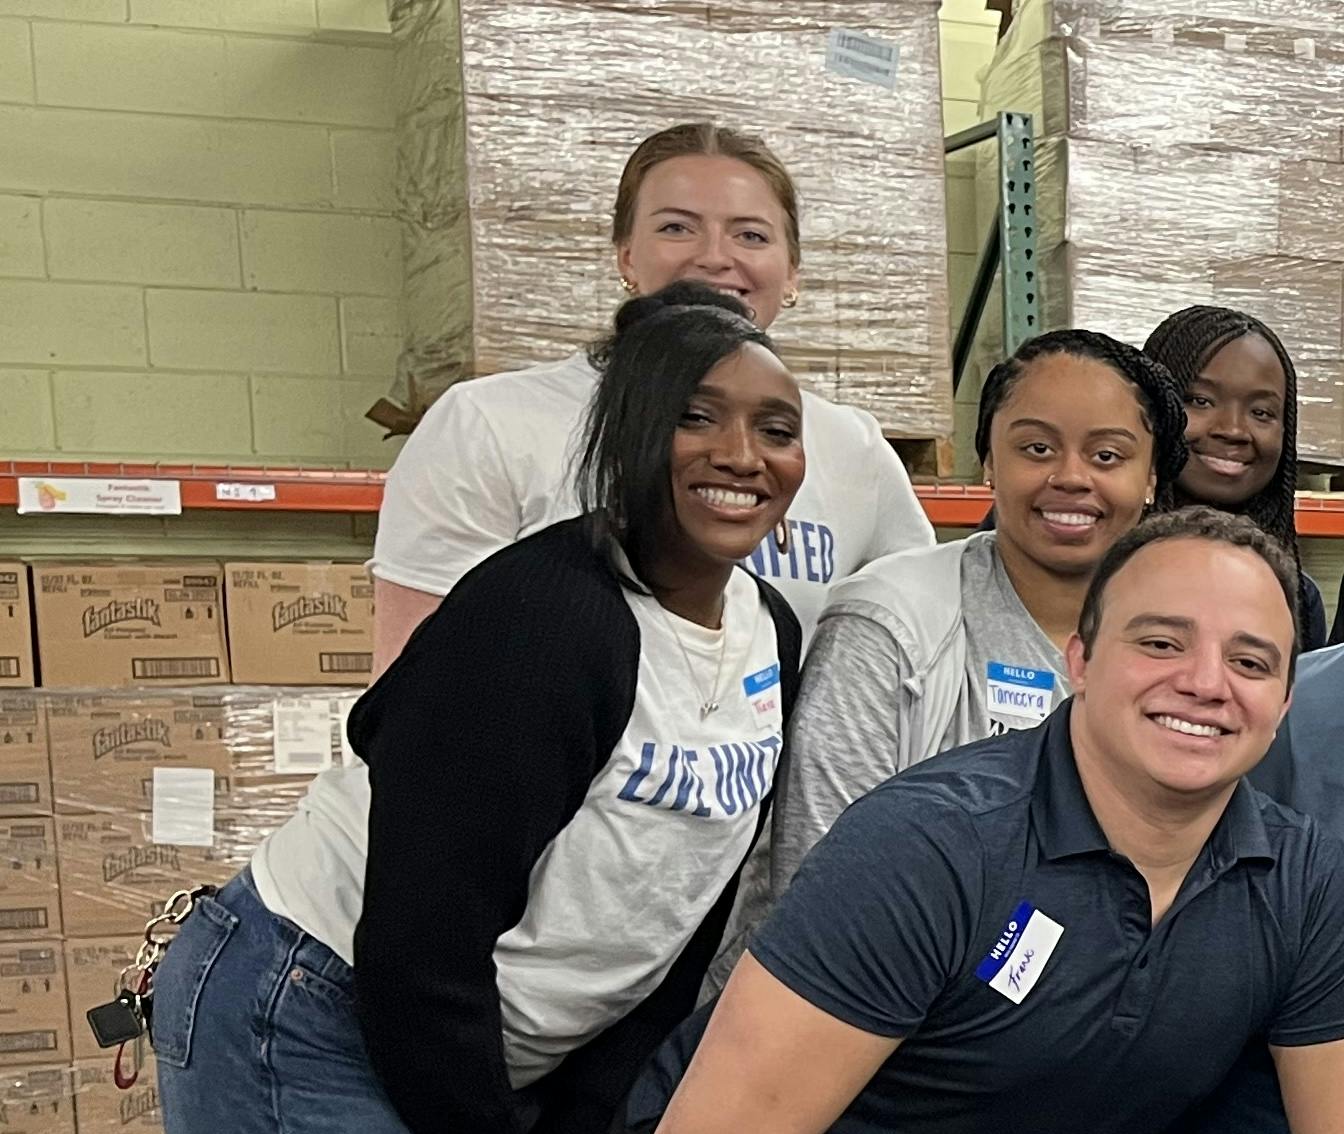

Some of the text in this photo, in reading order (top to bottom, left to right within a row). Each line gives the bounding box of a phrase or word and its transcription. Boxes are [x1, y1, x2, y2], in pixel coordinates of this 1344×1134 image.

[82, 598, 161, 638] fantastik
[272, 592, 348, 632] fantastik
[1003, 667, 1035, 680] HELLO
[92, 718, 171, 760] fantastik
[989, 921, 1018, 960] HELLO
